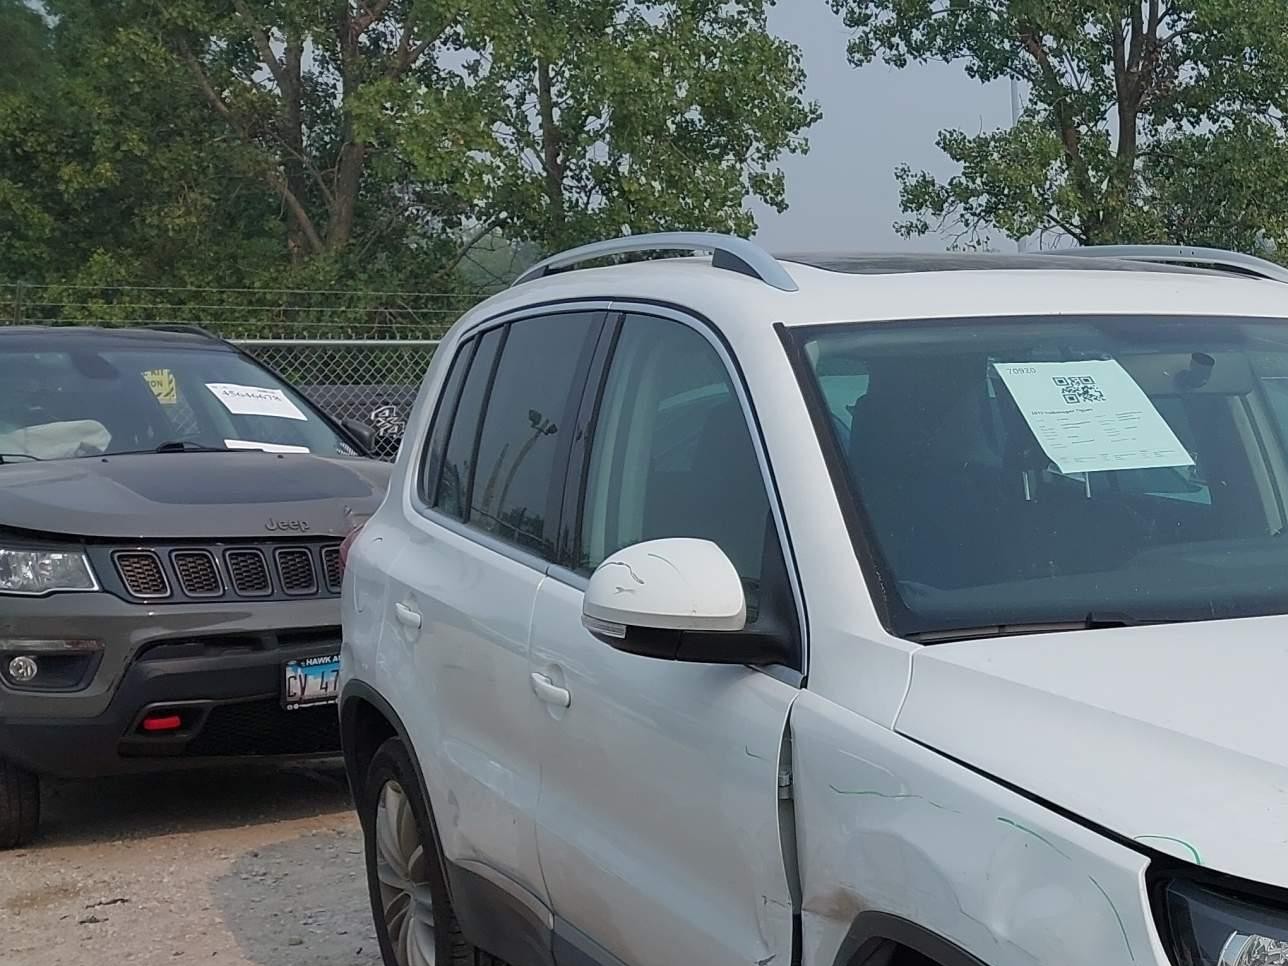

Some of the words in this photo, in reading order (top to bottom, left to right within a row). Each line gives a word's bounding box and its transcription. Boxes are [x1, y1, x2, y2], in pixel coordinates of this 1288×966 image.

[265, 517, 310, 533] Jeep
[305, 656, 331, 666] HAWK
[287, 673, 308, 698] CV
